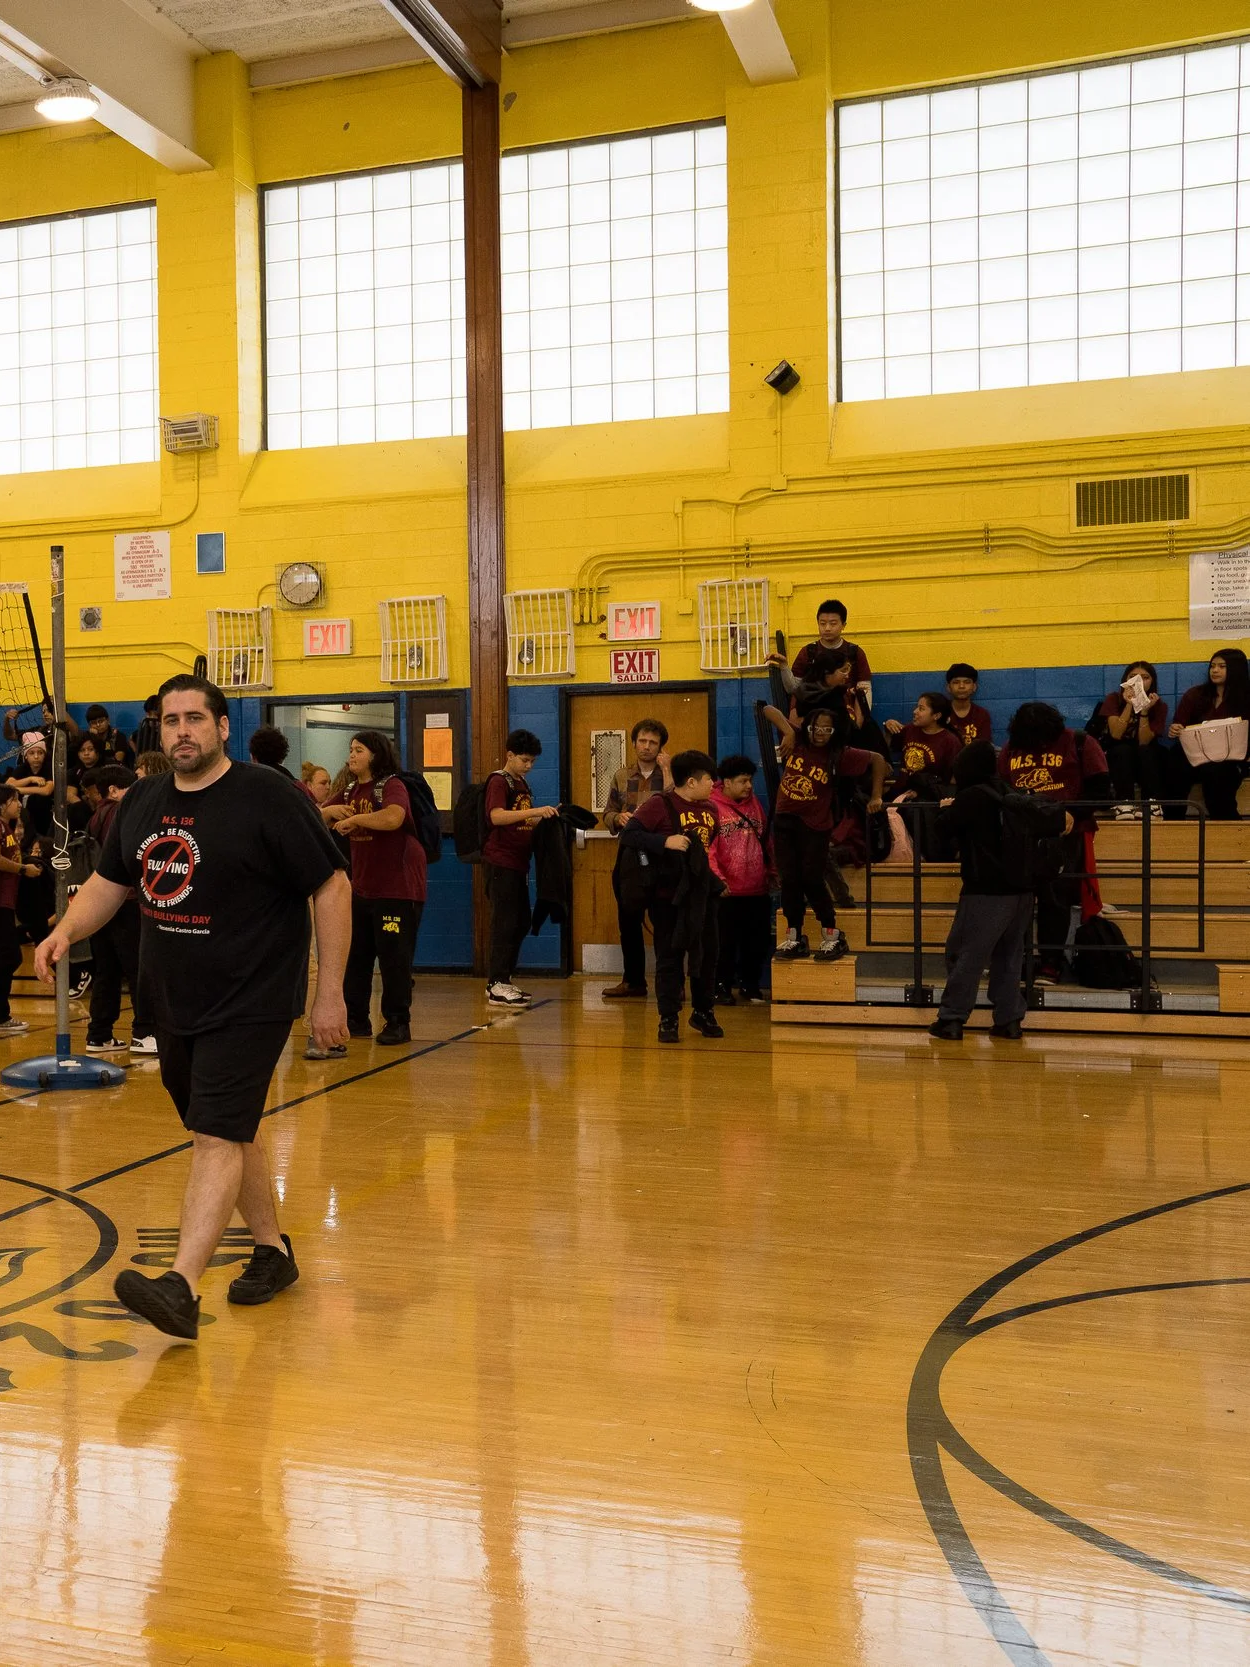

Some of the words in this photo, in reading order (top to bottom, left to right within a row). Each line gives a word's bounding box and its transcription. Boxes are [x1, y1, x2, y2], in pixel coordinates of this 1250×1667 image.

[1219, 551, 1248, 559] Physical
[614, 607, 656, 638] EXIT
[310, 624, 346, 655] EXIT
[613, 651, 656, 673] EXIT
[1010, 754, 1036, 771] M.S.
[1042, 753, 1063, 767] 136
[809, 766, 828, 784] 136
[162, 816, 177, 825] M.S.
[180, 817, 194, 825] 136
[136, 849, 144, 860] BE
[140, 833, 158, 850] KIND
[167, 828, 177, 836] BE
[157, 900, 166, 908] BE
[167, 884, 193, 907] FRIENDS
[154, 910, 190, 923] BULLYING
[192, 915, 211, 924] DAY
